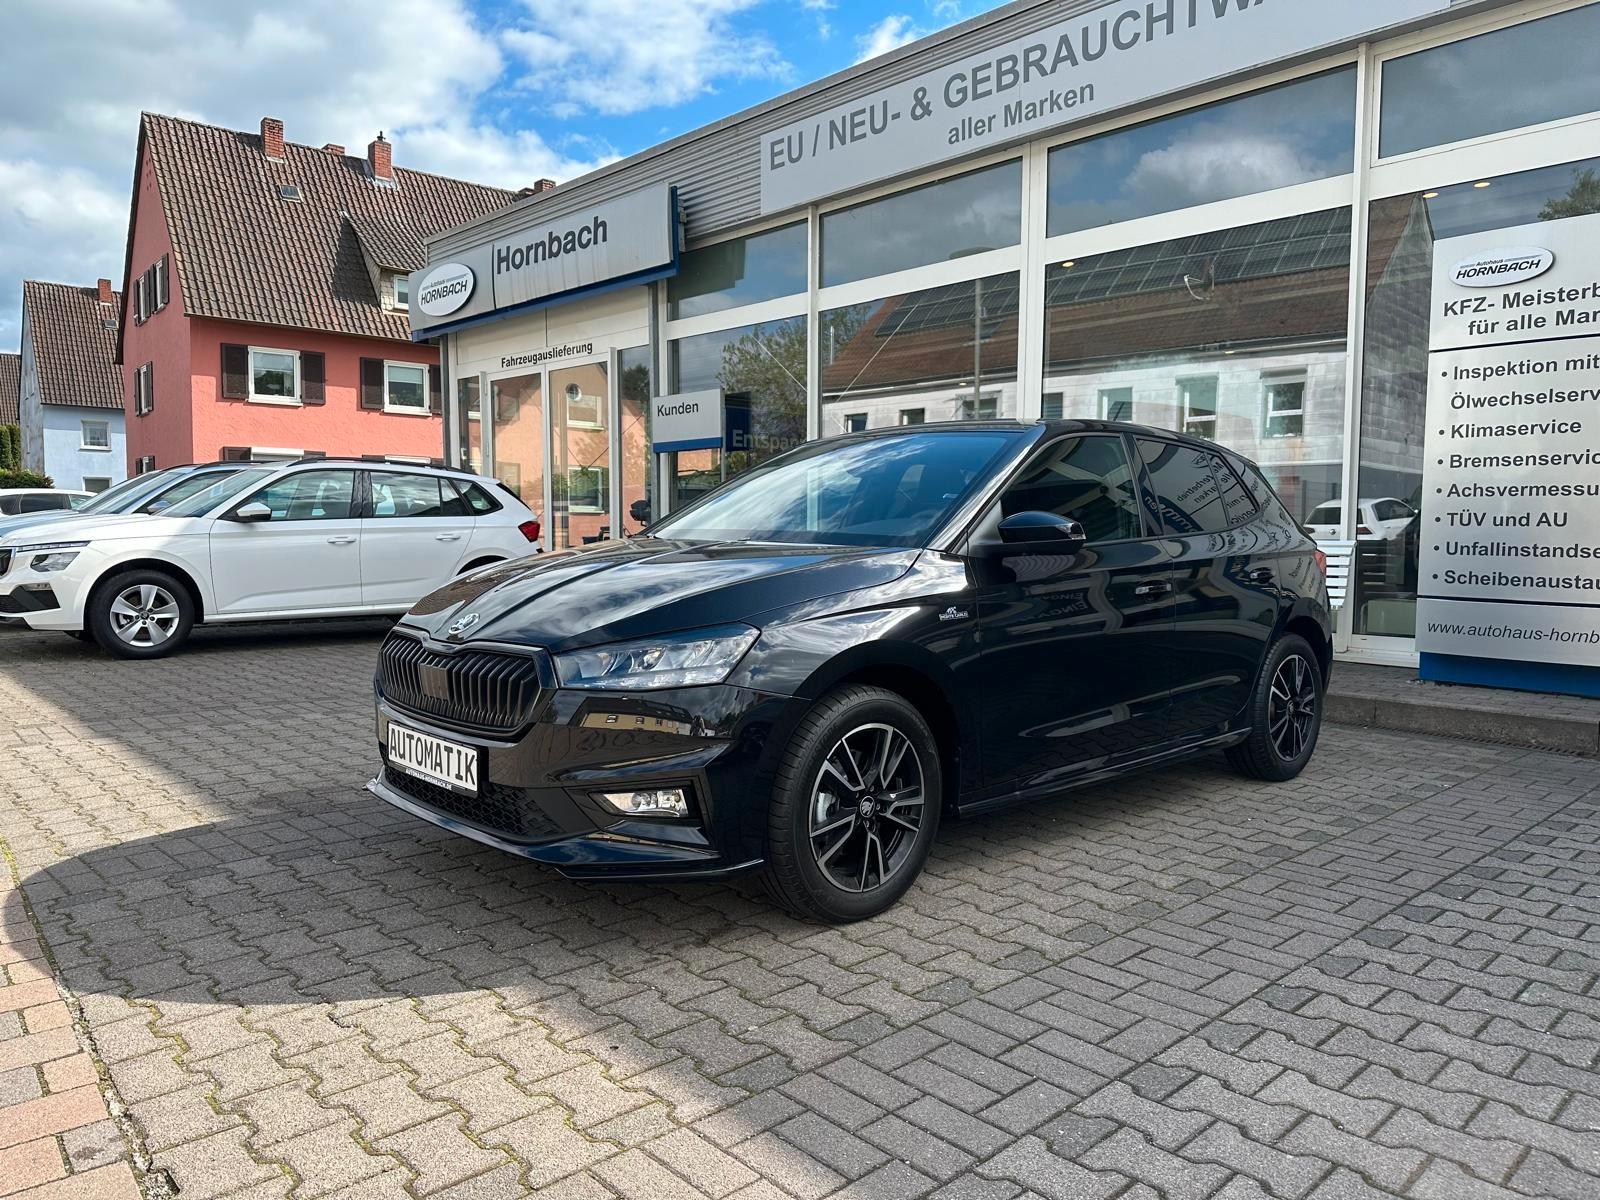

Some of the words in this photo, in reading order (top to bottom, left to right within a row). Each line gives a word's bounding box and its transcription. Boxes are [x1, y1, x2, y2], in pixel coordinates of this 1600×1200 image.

[770, 130, 803, 170] EU
[812, 124, 820, 157] /
[829, 100, 901, 150] NEU-
[910, 86, 933, 121] &
[943, 0, 1264, 109] GEBRAUCHT
[948, 114, 996, 145] aller
[1004, 83, 1094, 128] Marken
[496, 216, 608, 275] Hornbach
[1456, 259, 1541, 280] HORNBACH
[1476, 258, 1504, 267] Autohaus
[420, 279, 468, 305] HORNBACH
[1443, 296, 1495, 317] KFZ-
[1502, 282, 1600, 309] Meisterb
[1468, 319, 1499, 335] für
[1505, 313, 1547, 331] alle
[1555, 309, 1600, 326] Mar
[500, 340, 593, 369] Fahrzeugauslieferung
[1453, 360, 1558, 382] Inspektion
[1565, 354, 1600, 371] mit
[657, 402, 699, 417] Kunden
[1450, 388, 1600, 409] Ölwechselserv
[1451, 419, 1582, 439] Klimaservice
[1450, 449, 1600, 468] Bremsenservic
[1446, 483, 1600, 498] Achsvermessu
[1447, 509, 1487, 527] TÜV
[1493, 512, 1530, 527] und
[1536, 512, 1568, 527] AU
[1446, 541, 1600, 559] Unfallinstandse
[1427, 622, 1600, 645] www.autohaus-hornb
[389, 727, 476, 786] AUTOMATIK
